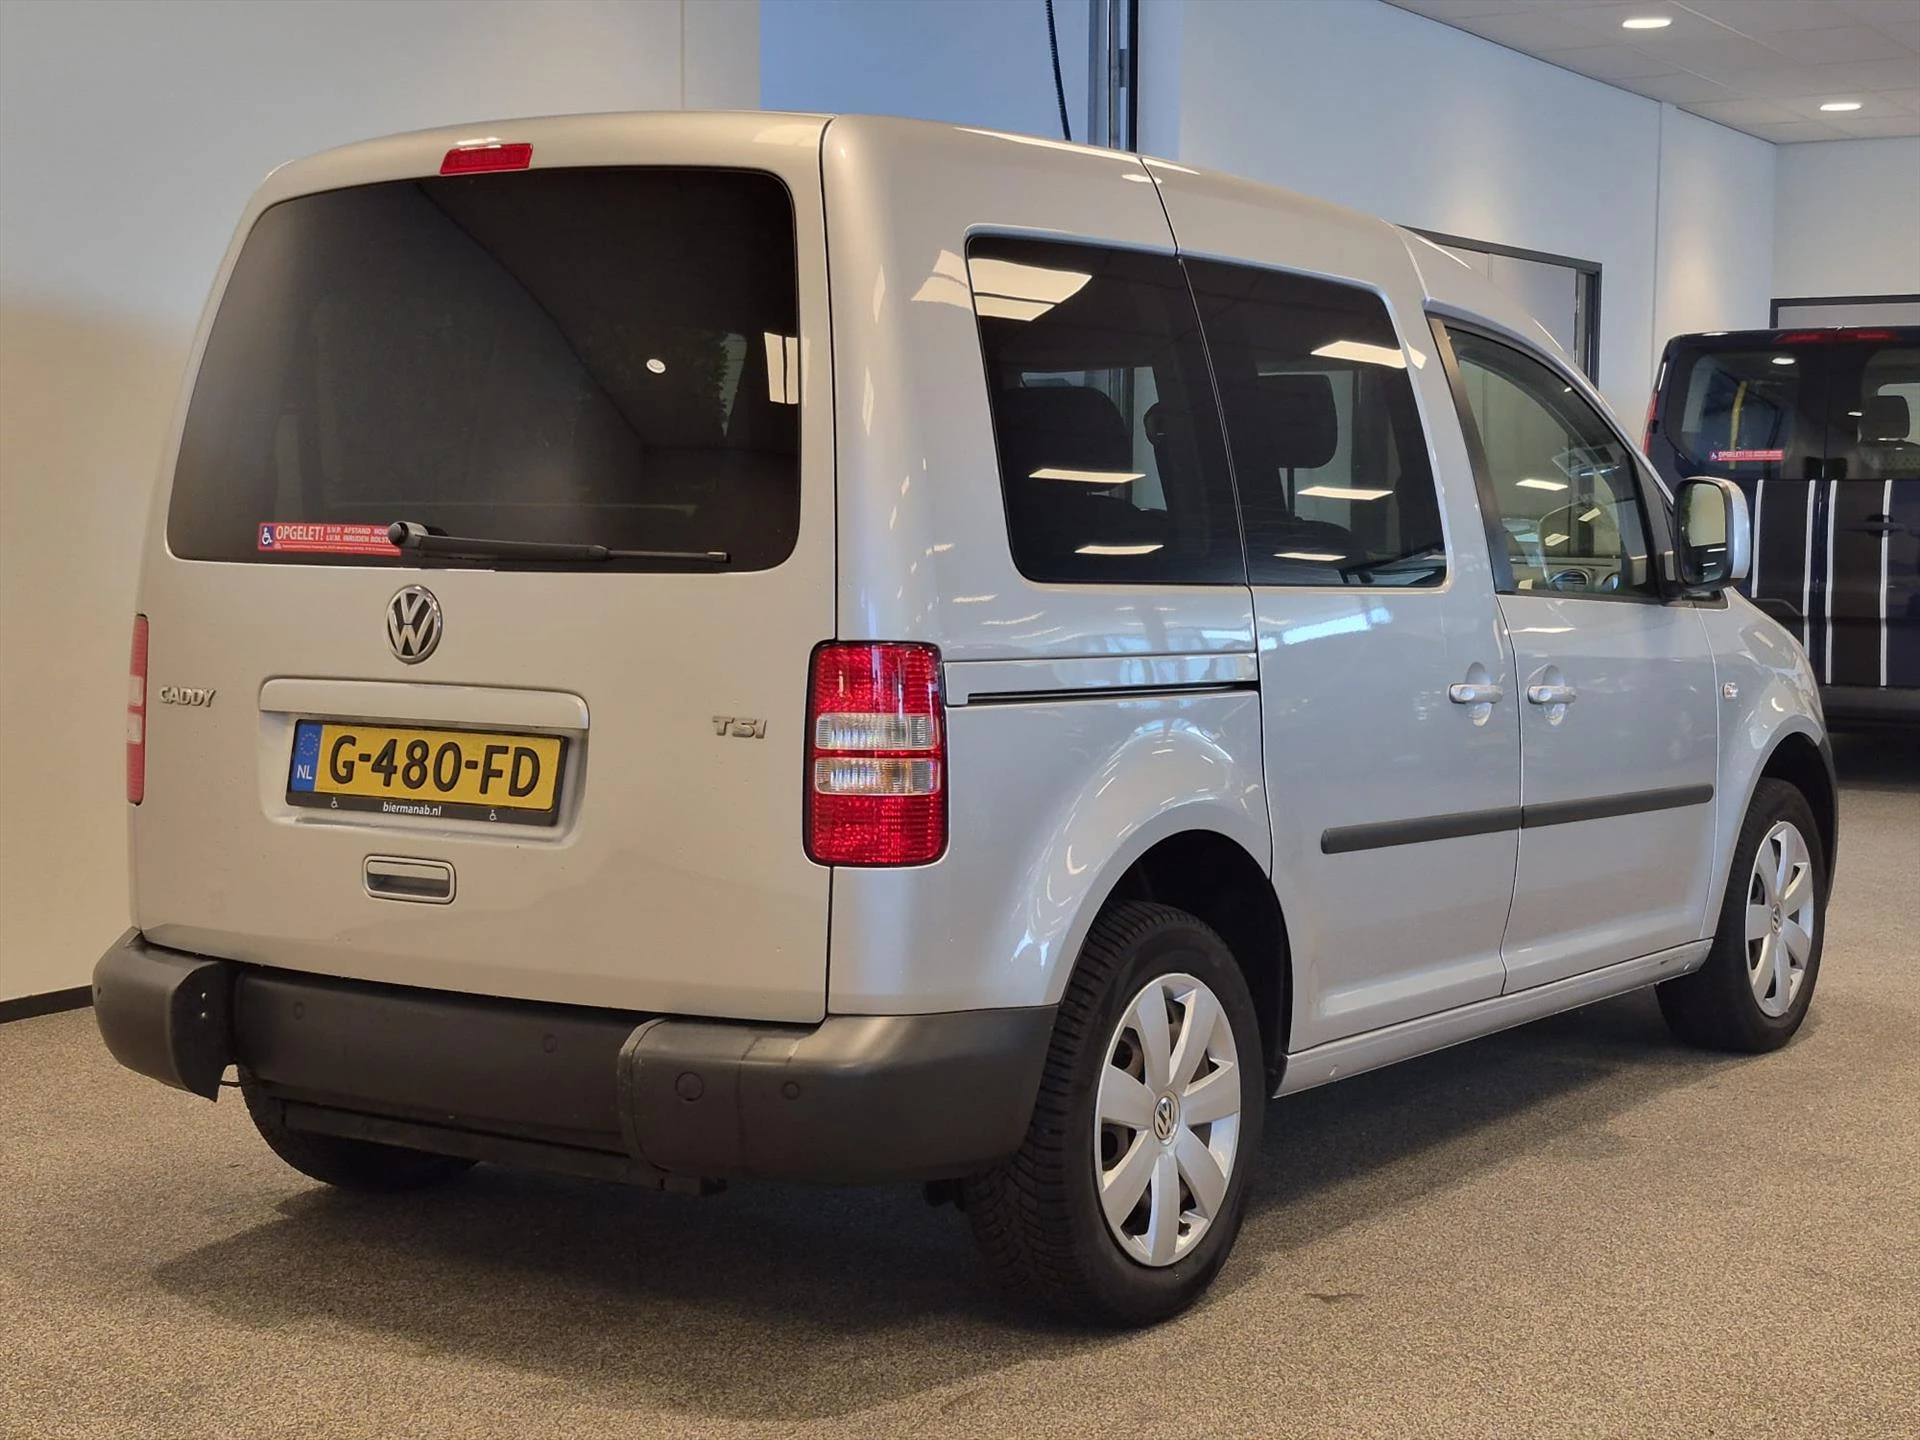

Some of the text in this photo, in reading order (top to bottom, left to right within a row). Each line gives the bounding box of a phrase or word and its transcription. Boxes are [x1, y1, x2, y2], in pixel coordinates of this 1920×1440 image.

[275, 525, 324, 541] OPGELET!
[343, 526, 371, 535] AFSTAND
[374, 527, 389, 536] HOU
[370, 535, 391, 544] ROLST
[385, 584, 443, 665] VW
[160, 686, 216, 708] CADDY
[712, 716, 767, 739] TSI
[296, 764, 313, 780] NL
[329, 734, 541, 798] G-480-FD
[382, 801, 442, 817] biermanab.nl
